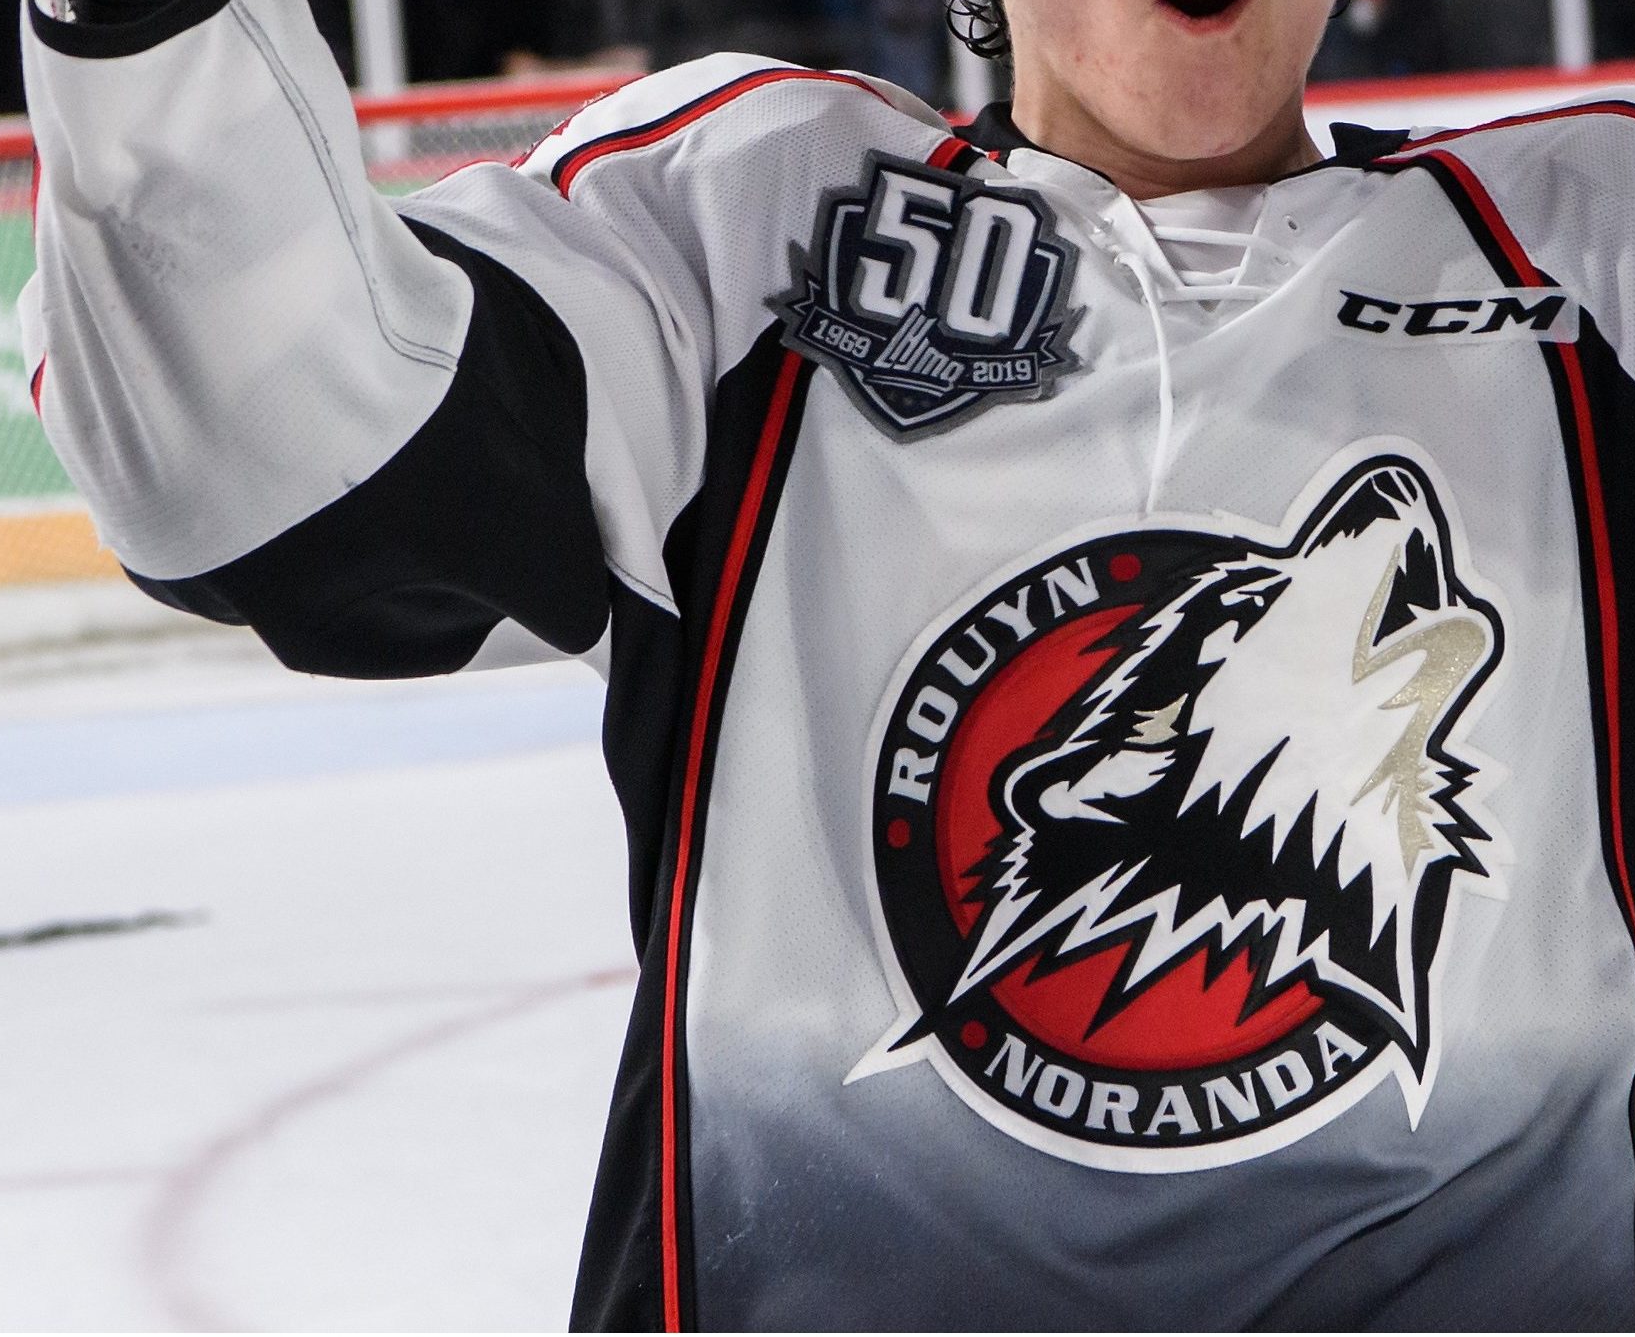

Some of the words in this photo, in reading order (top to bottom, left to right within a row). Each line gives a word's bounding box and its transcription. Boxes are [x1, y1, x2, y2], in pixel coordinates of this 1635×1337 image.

[848, 168, 1037, 340] 50
[811, 318, 872, 359] 1969
[1337, 288, 1568, 337] CCM
[971, 358, 1032, 383] 2019
[888, 555, 1106, 807] ROUYN
[982, 1024, 1368, 1139] NORANDA
